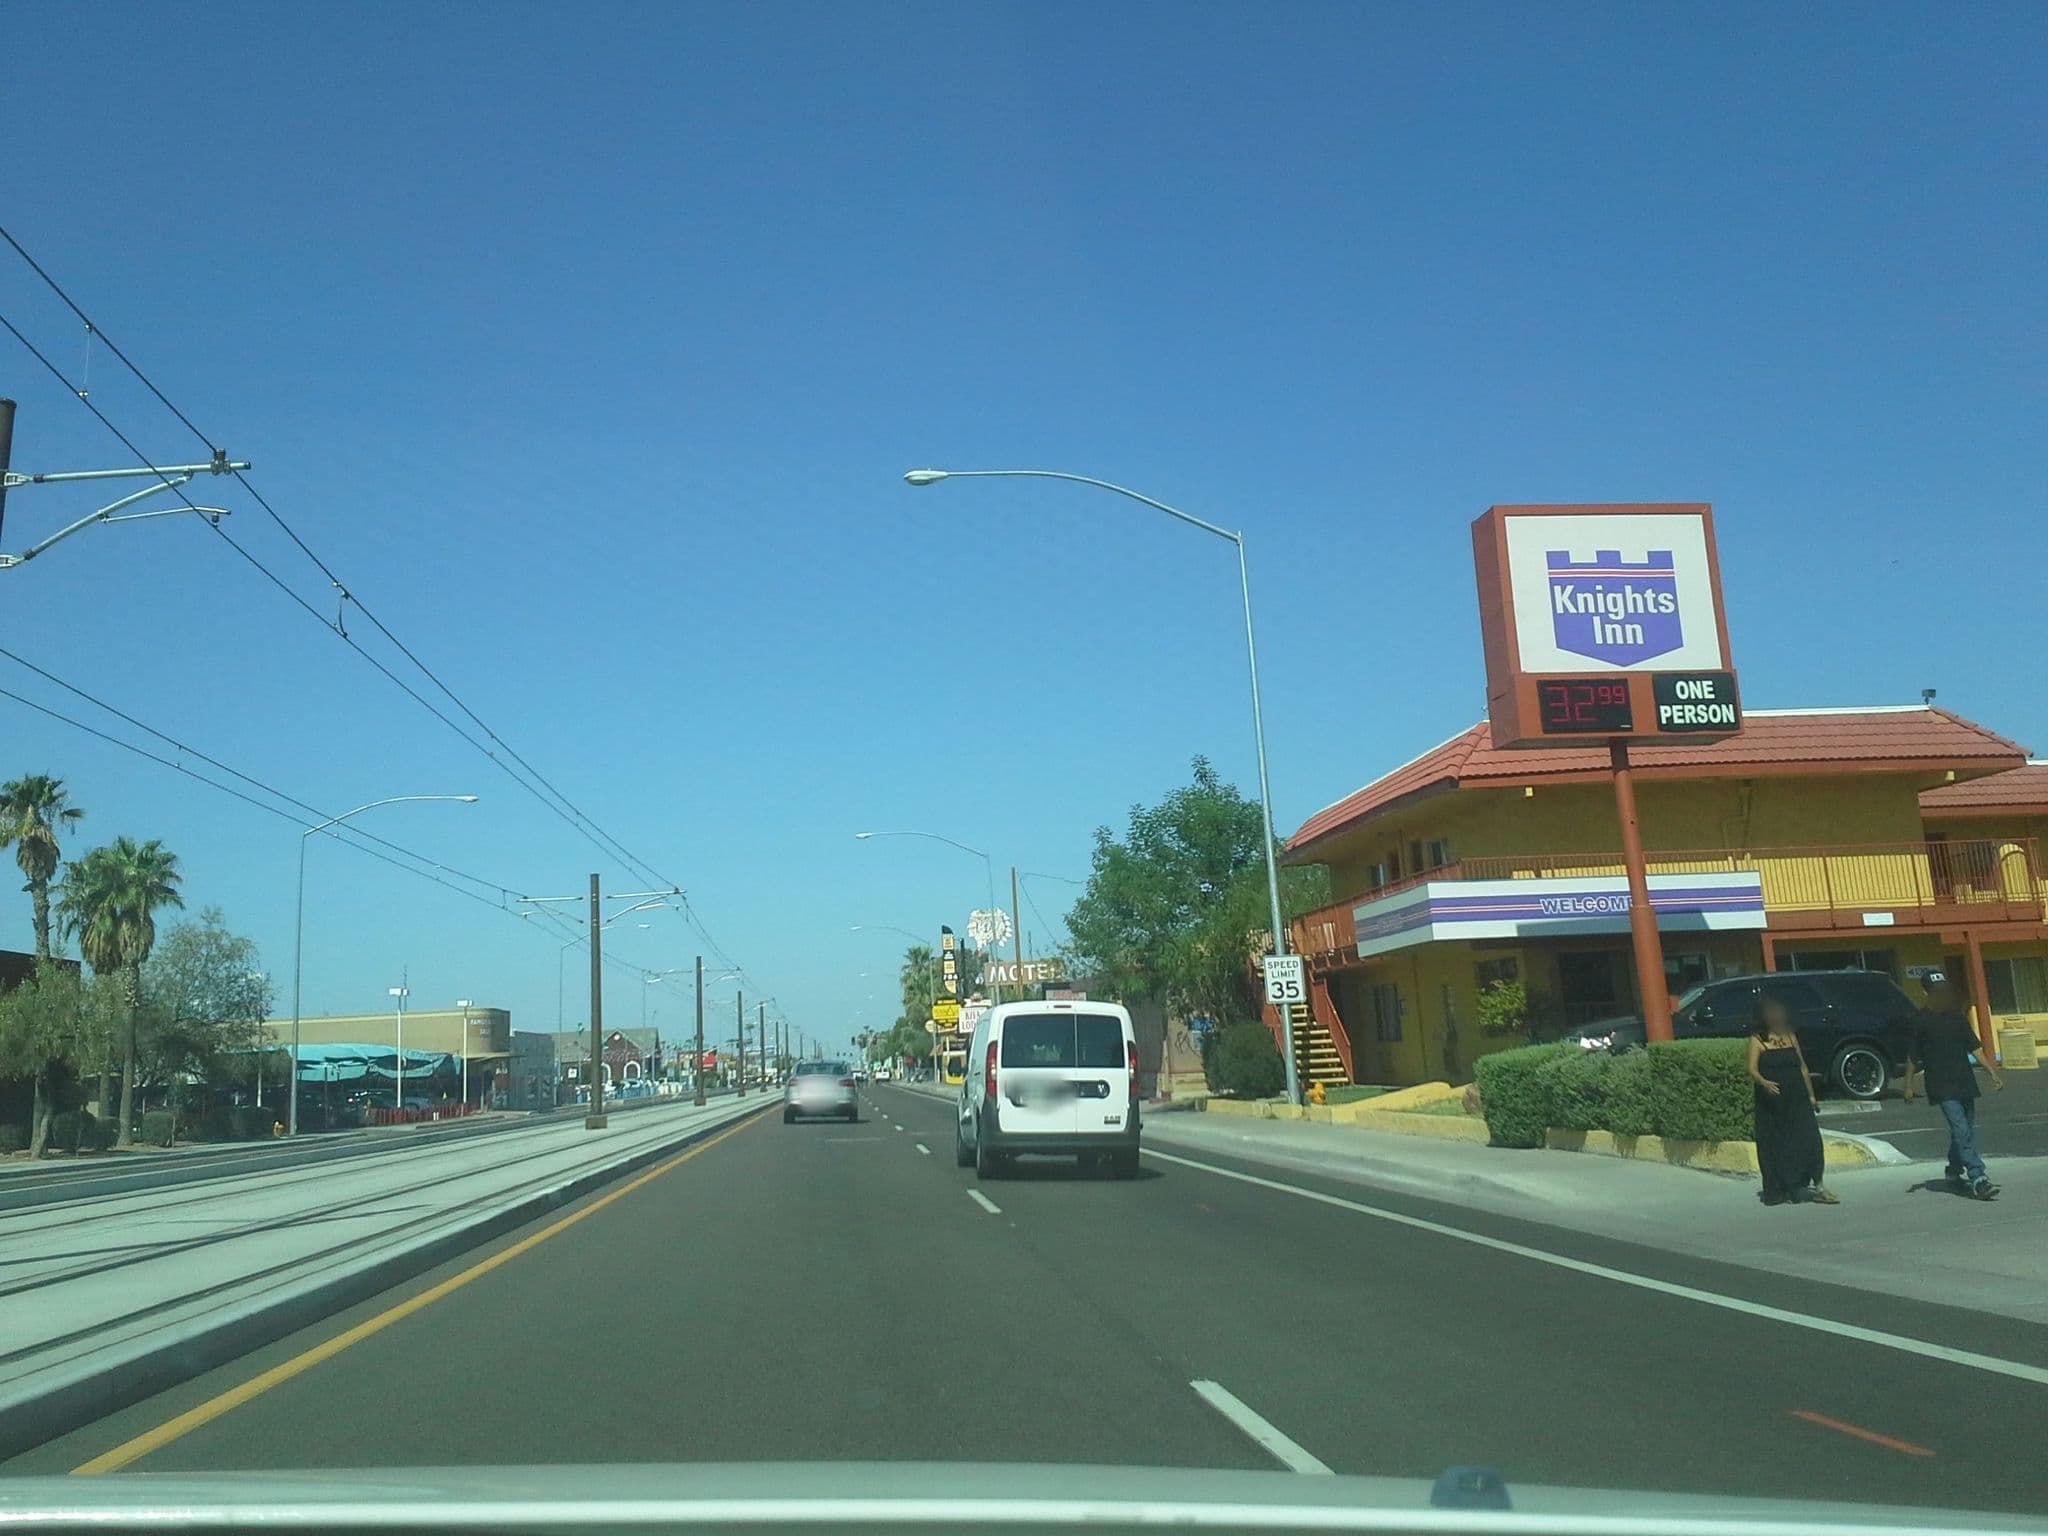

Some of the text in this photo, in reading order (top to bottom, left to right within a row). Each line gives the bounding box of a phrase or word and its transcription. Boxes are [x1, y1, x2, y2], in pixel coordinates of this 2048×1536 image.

[1553, 584, 1676, 620] Knights
[1592, 616, 1645, 645] Inn
[1675, 680, 1716, 700] ONE
[1659, 703, 1736, 725] PERSON
[1267, 960, 1299, 970] SPEED
[1271, 969, 1296, 979] LIMIT
[1271, 980, 1300, 999] 35
